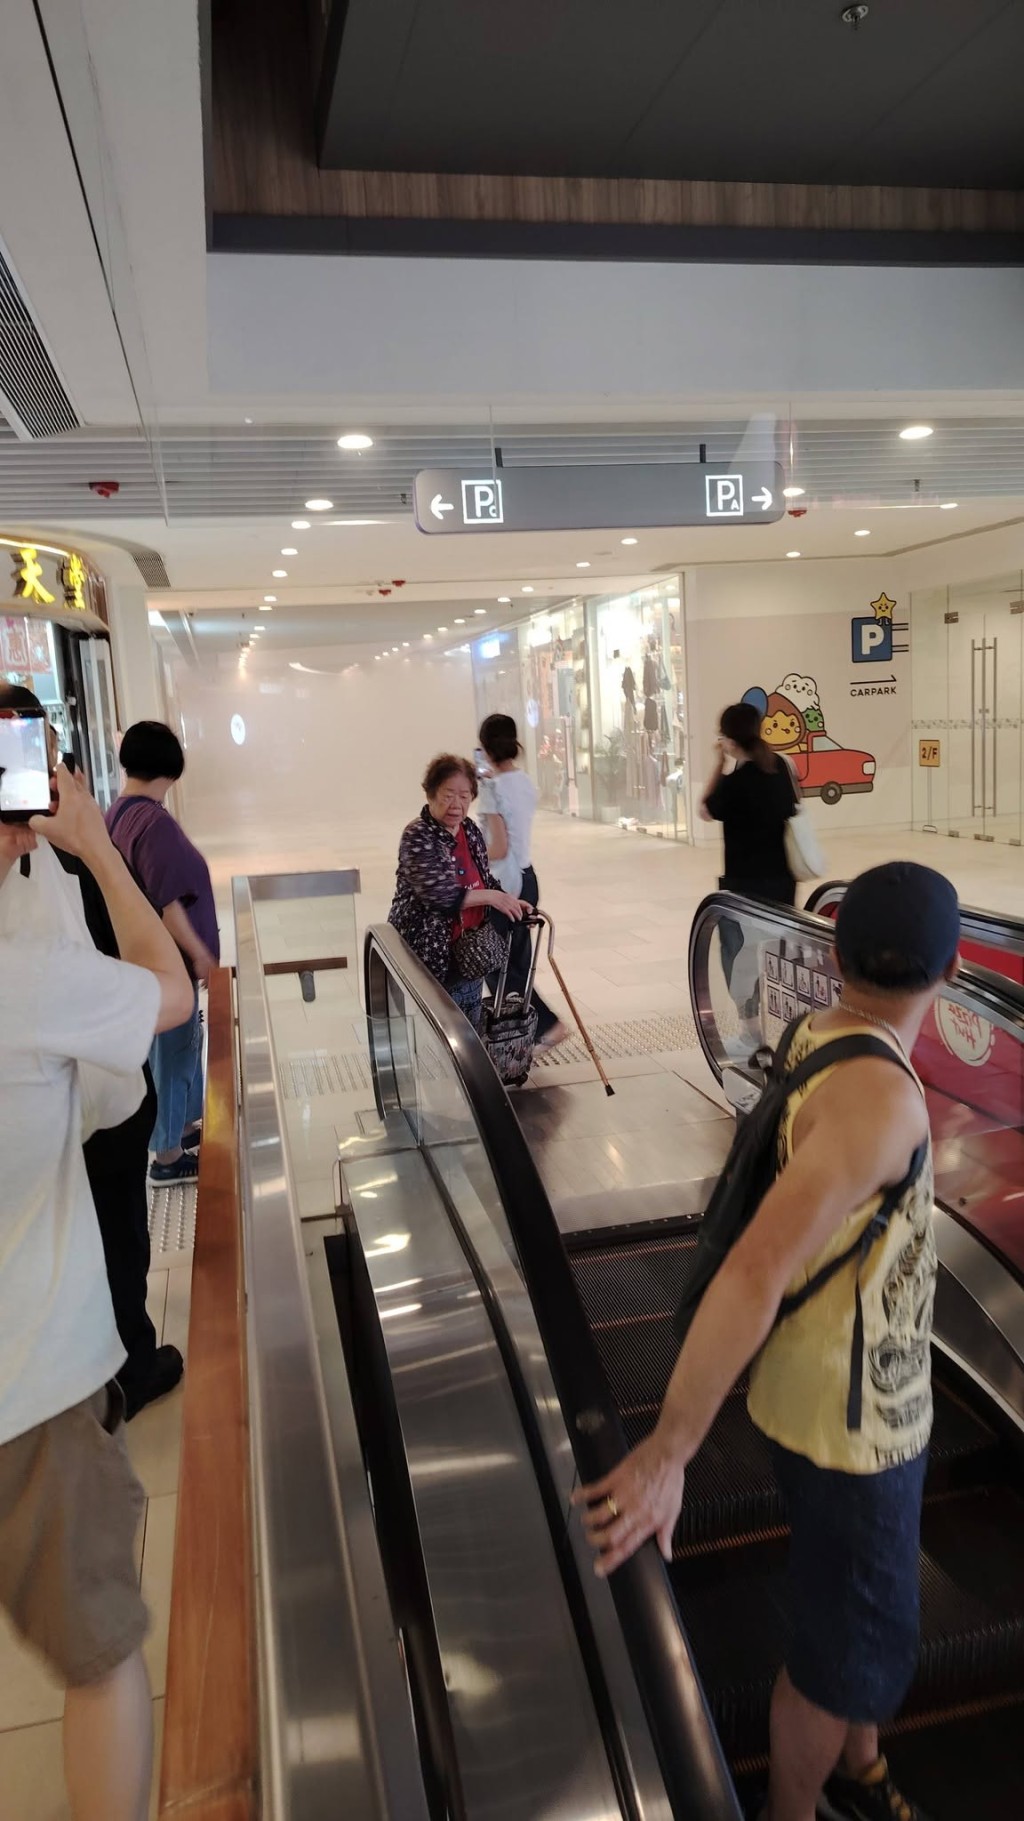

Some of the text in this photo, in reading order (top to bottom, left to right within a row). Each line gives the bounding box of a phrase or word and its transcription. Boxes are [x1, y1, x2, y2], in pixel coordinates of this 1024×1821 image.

[861, 624, 885, 655] P
[850, 686, 897, 697] CARPARK
[921, 746, 938, 760] 2/F
